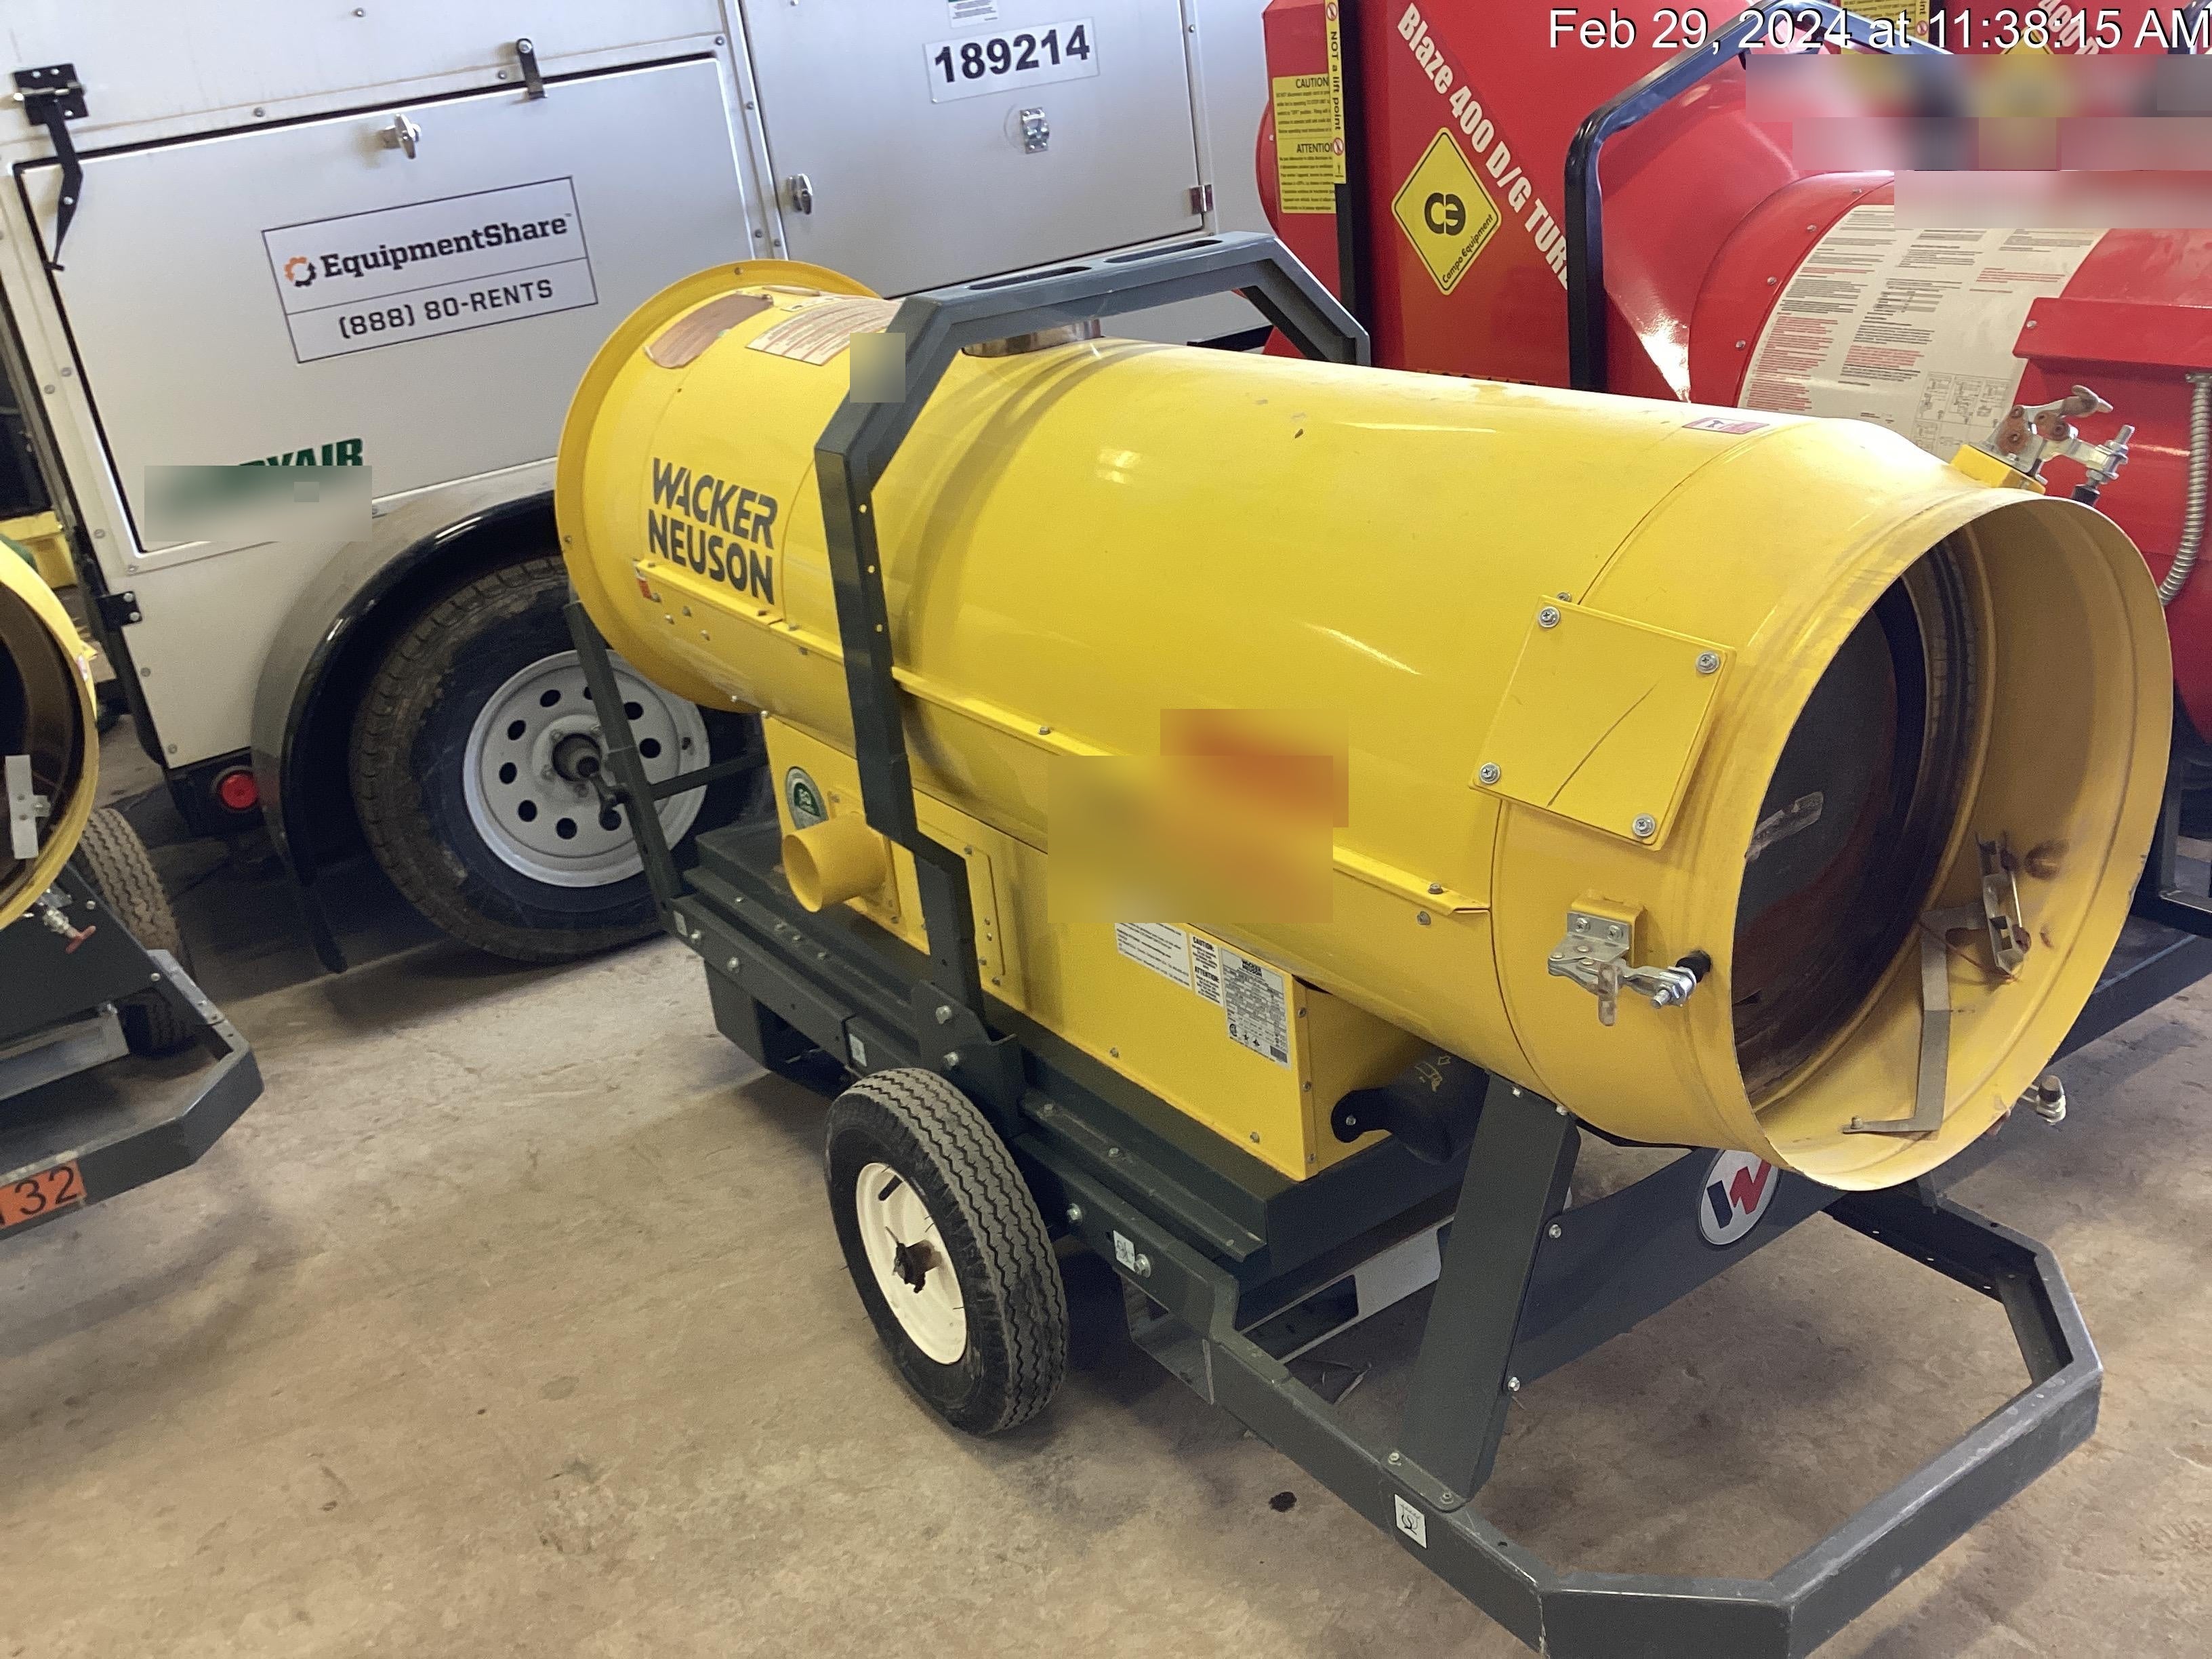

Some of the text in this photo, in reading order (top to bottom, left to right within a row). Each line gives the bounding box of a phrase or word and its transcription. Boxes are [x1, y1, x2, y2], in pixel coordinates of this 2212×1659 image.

[934, 24, 1090, 83] 189214
[1330, 31, 1339, 61] NOT
[1295, 77, 1328, 89] CAUTION
[1397, 2, 1454, 94] Blaze
[1449, 85, 1495, 154] 400
[1485, 140, 1533, 213] D/G
[1332, 97, 1341, 130] point
[1441, 213, 1494, 284] Campo Equipment
[338, 279, 554, 340] (888) 80-RENTS
[652, 457, 778, 550] WACKER
[648, 508, 775, 605] NEUSON
[0, 1166, 77, 1226] 32
